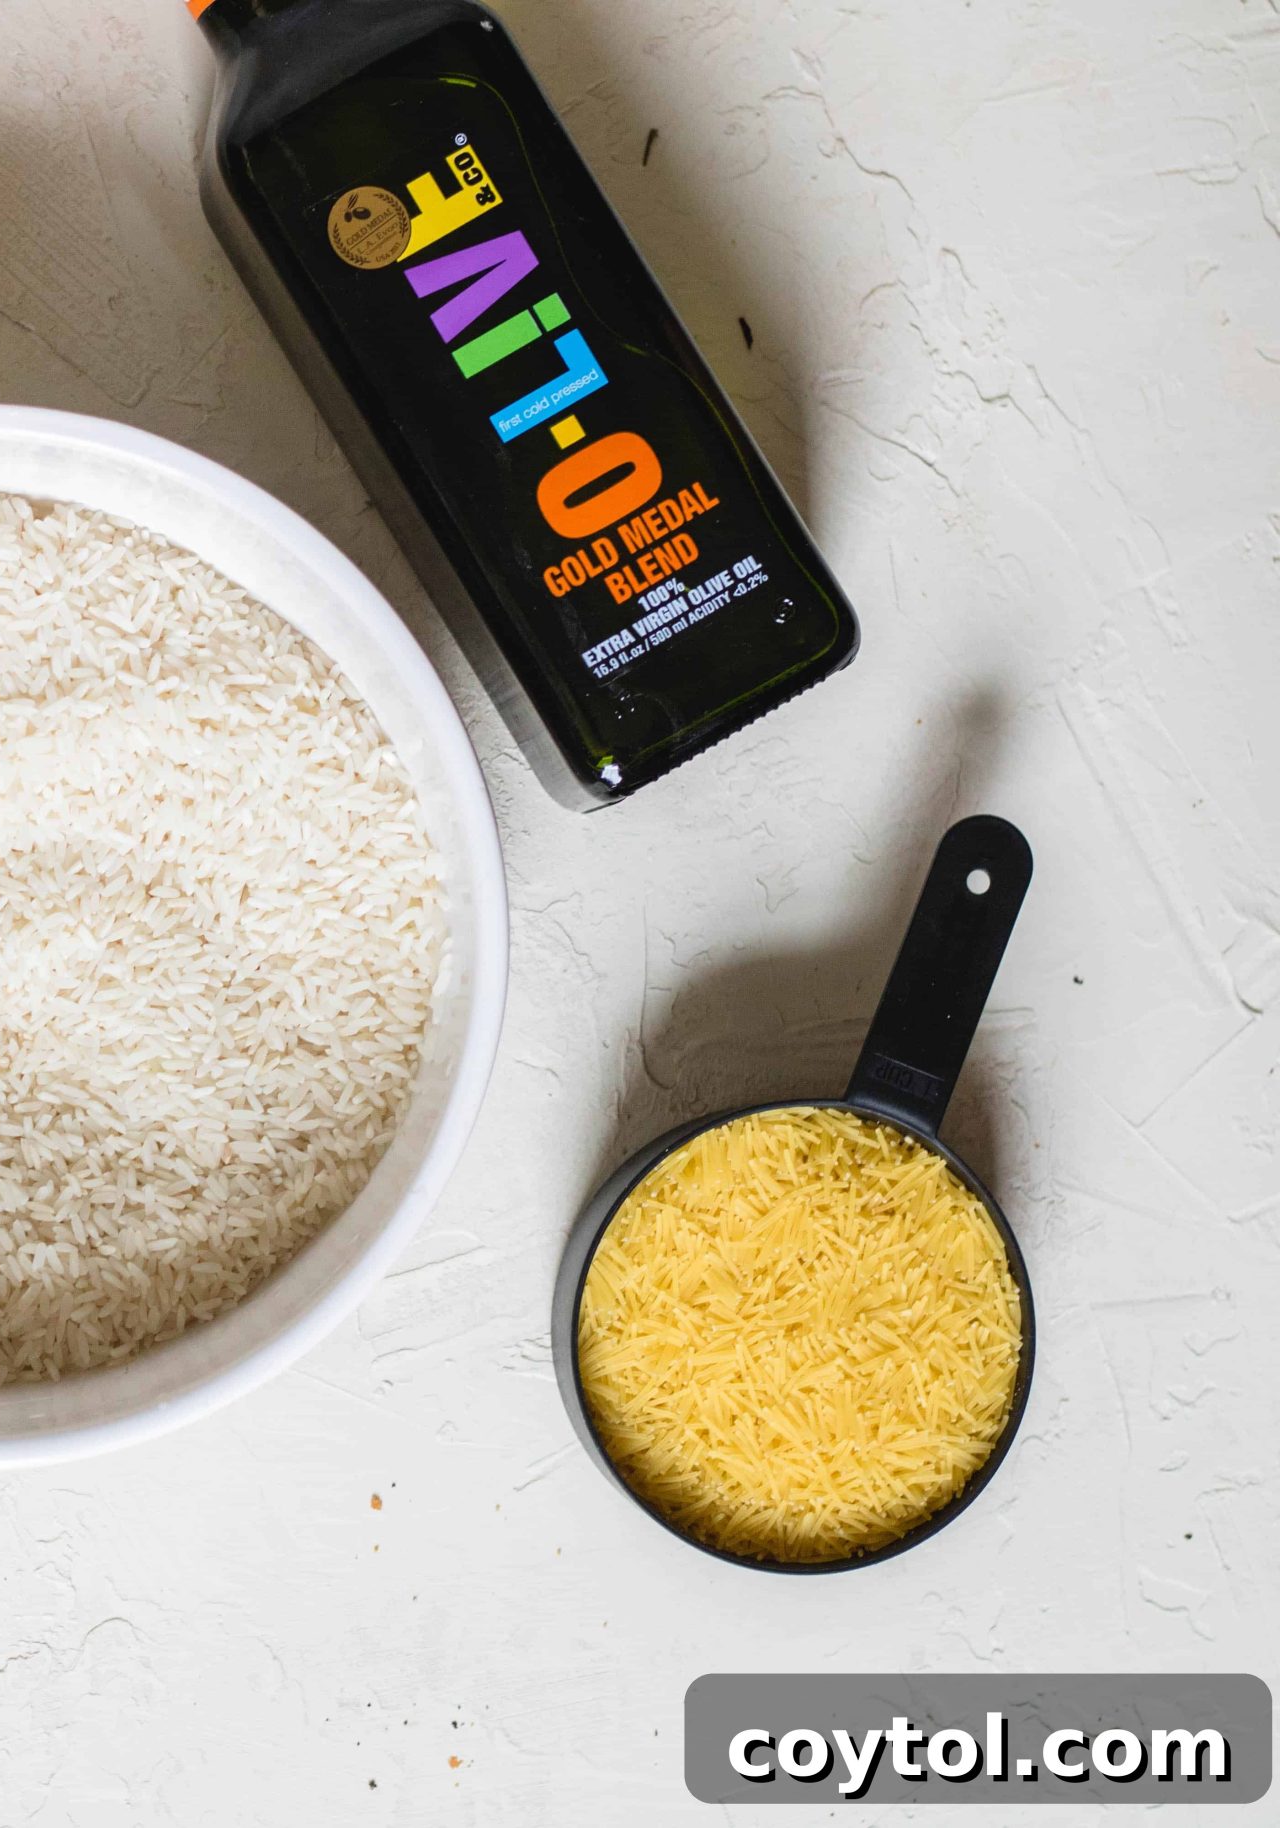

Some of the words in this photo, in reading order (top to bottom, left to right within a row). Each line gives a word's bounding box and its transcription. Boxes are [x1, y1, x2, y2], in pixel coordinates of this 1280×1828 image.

[346, 227, 368, 246] GOLD
[367, 208, 394, 230] MEDAL
[498, 414, 523, 433] first
[523, 396, 550, 418] cold
[550, 368, 600, 405] pressed
[543, 537, 620, 598] GOLD
[616, 481, 720, 554] MEDAL
[604, 532, 700, 604] BLEND
[581, 628, 636, 668] EXTRA
[632, 596, 690, 637] VIRGIN
[687, 570, 734, 605] OLIVE
[732, 554, 763, 580] OIL
[637, 577, 685, 612] 100%
[593, 657, 620, 679] 16.9
[651, 626, 673, 647] 500
[672, 617, 689, 634] ml
[688, 591, 731, 624] ACIDITY
